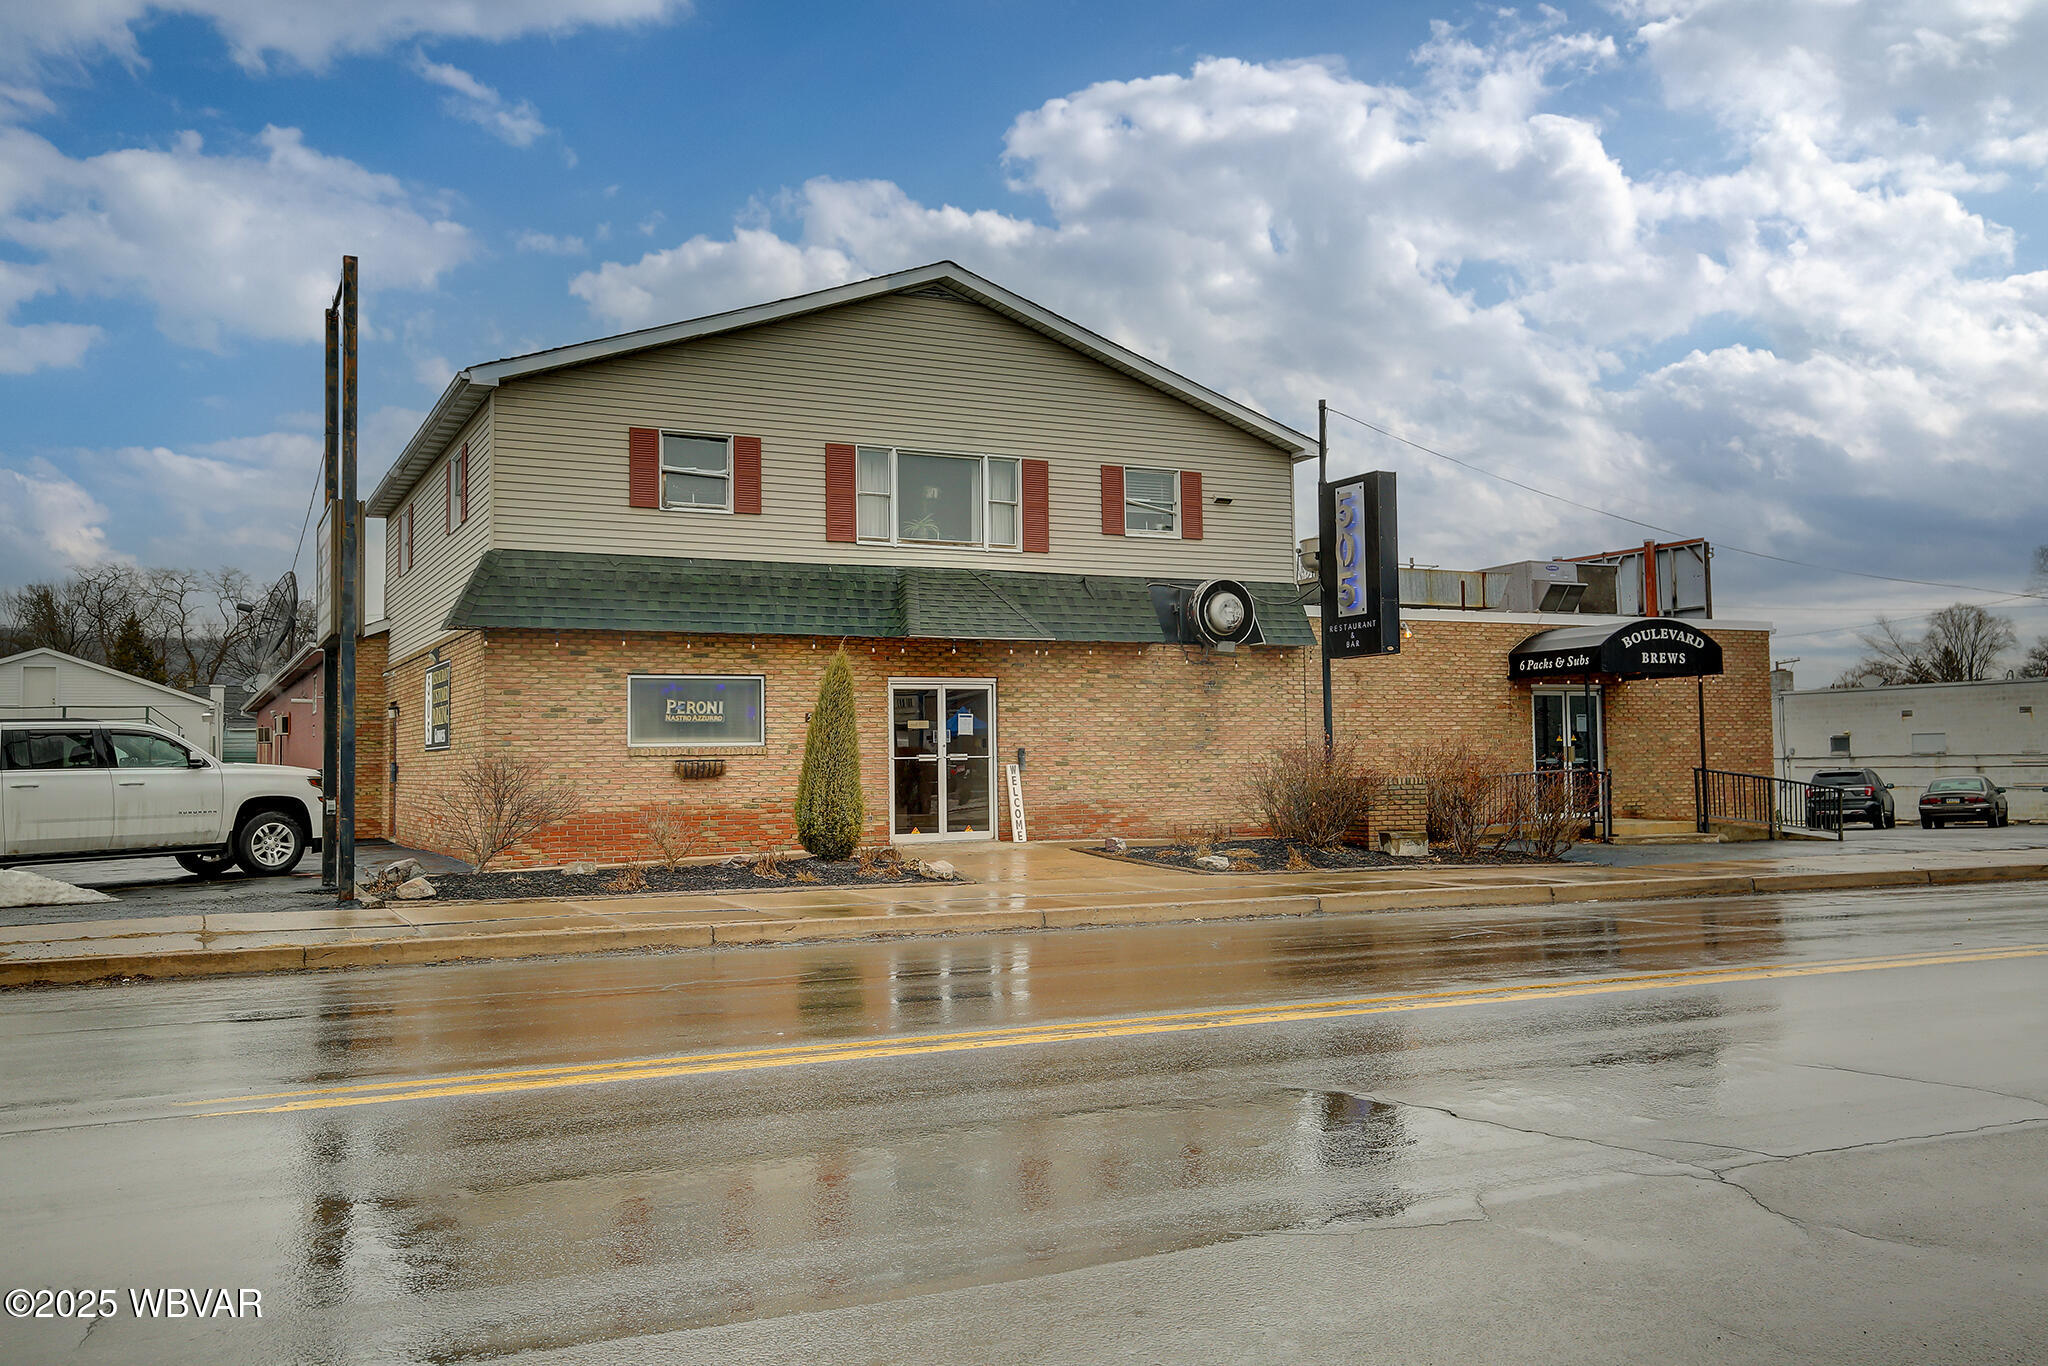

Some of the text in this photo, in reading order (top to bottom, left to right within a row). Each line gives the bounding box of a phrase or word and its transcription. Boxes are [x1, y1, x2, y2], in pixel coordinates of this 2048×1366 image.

[1329, 620, 1377, 633] RESTAURANT
[1346, 640, 1360, 648] BAR
[1621, 628, 1705, 649] BOULEVARD
[1519, 654, 1590, 671] 6 Packs & Subs
[1642, 652, 1686, 664] BREWS
[666, 699, 724, 714] PERONI
[666, 714, 723, 722] NASTRO AZZURRO
[1009, 765, 1023, 841] WELCOME
